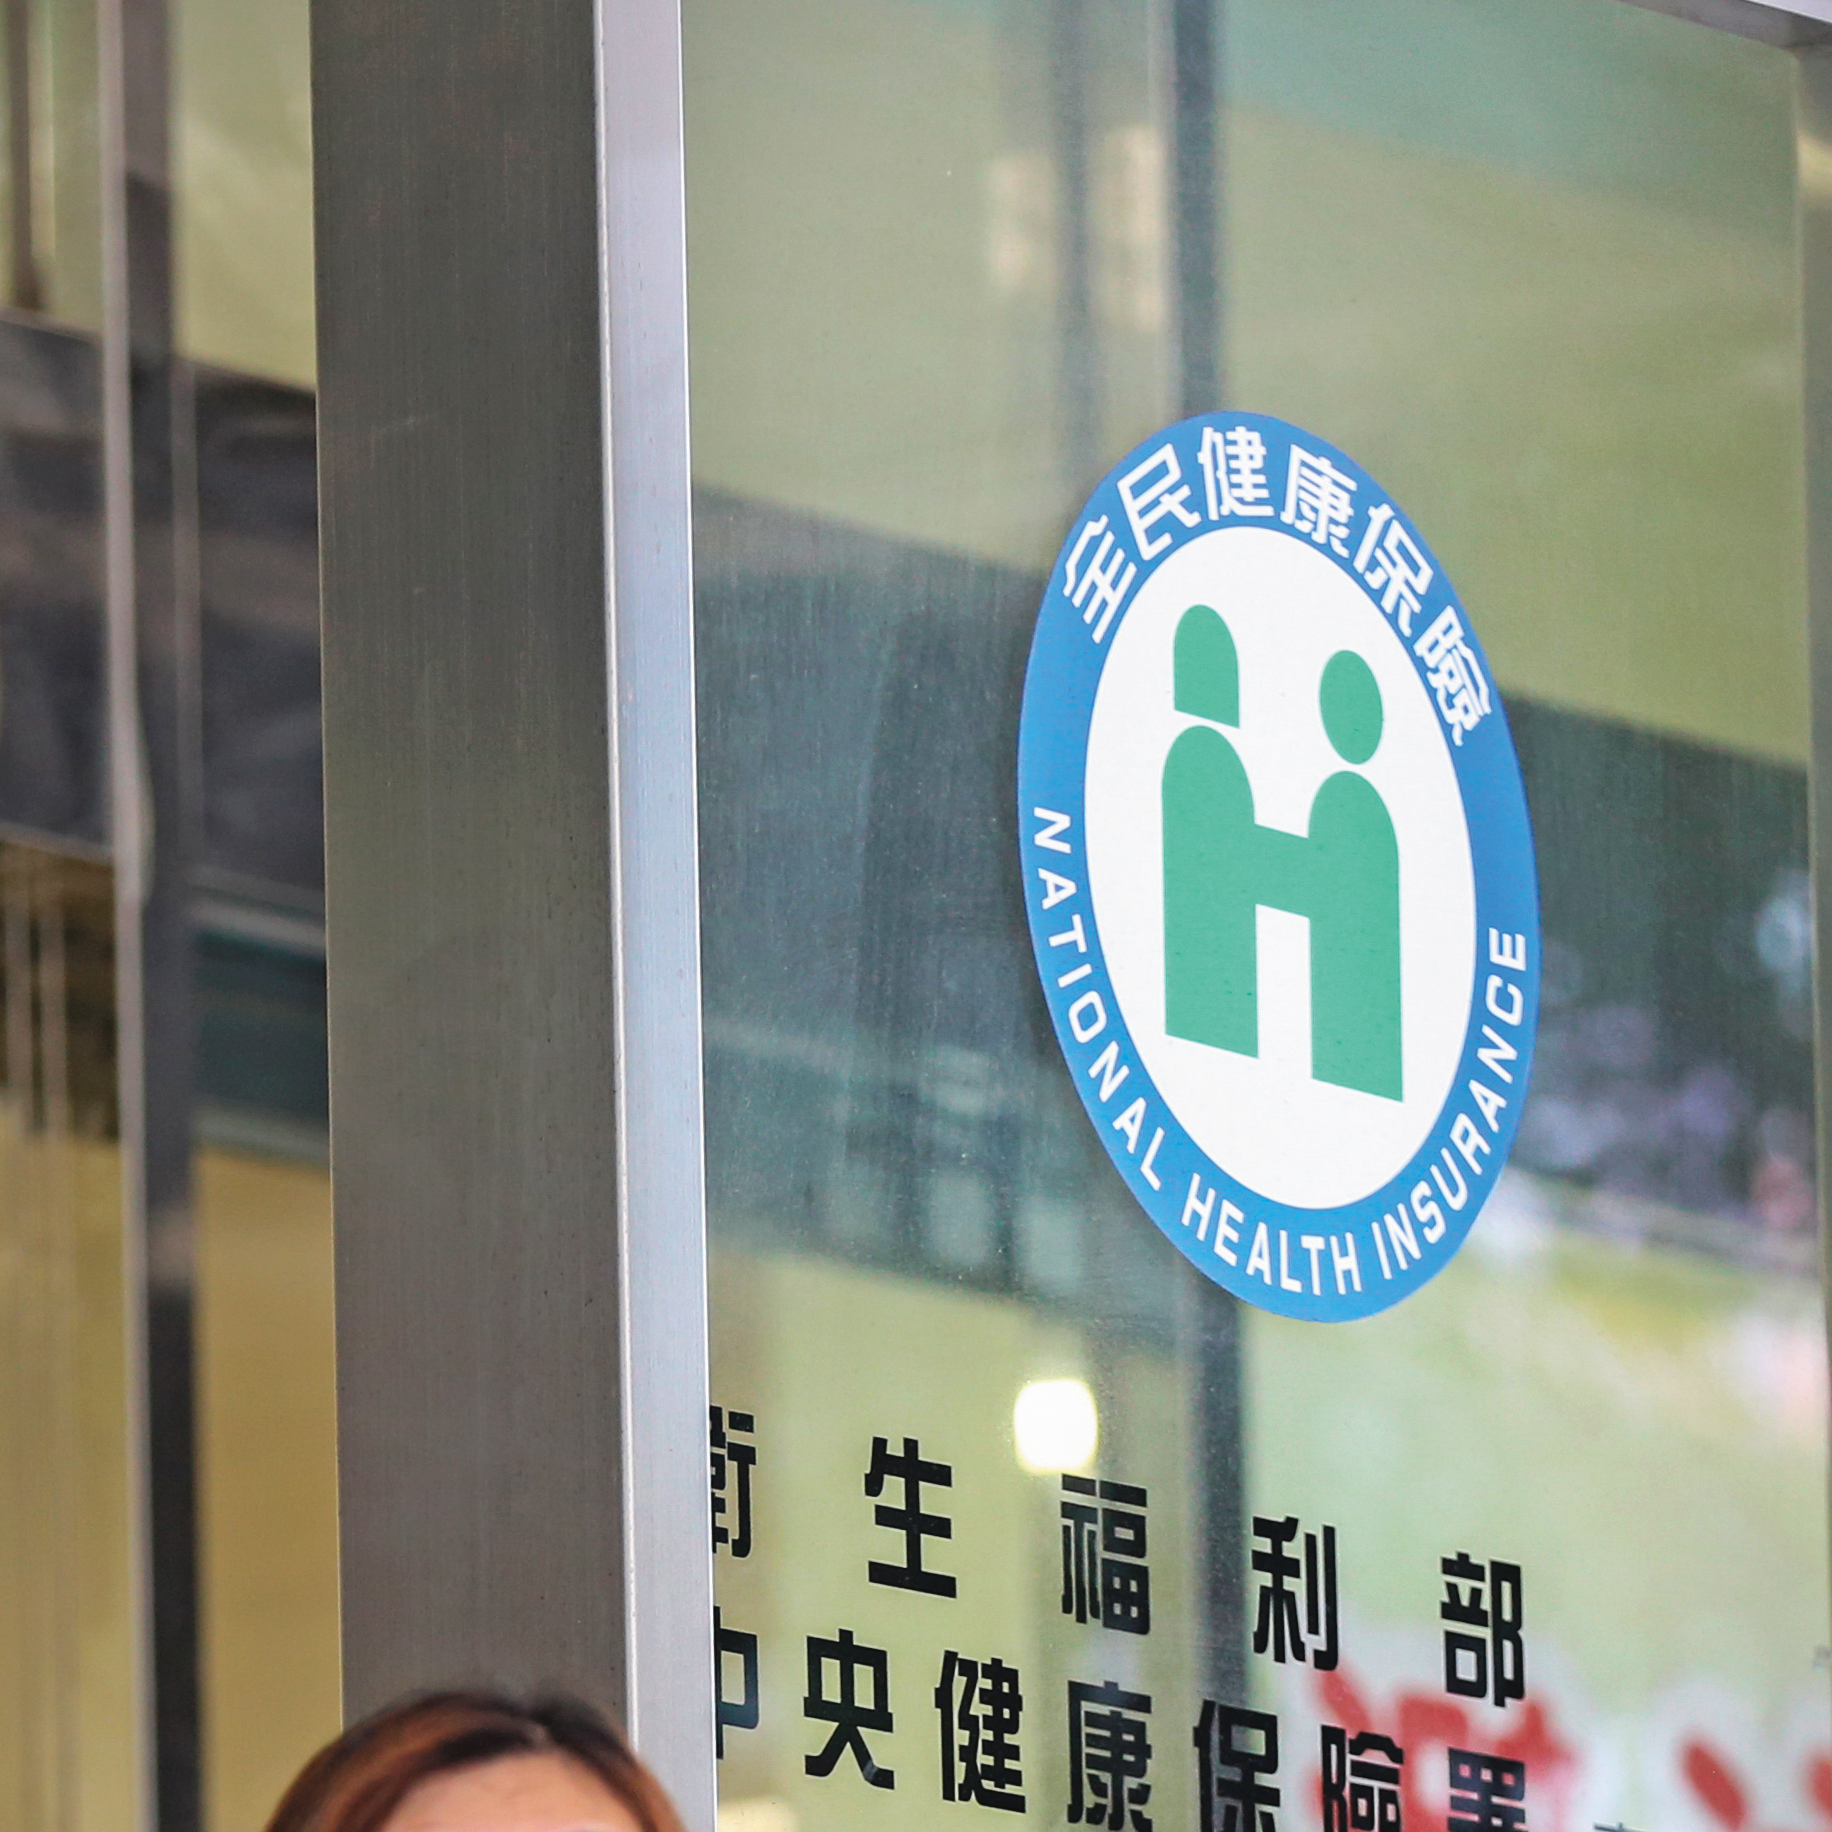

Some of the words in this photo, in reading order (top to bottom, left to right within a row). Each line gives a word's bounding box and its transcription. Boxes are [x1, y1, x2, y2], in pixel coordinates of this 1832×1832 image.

[1064, 426, 1492, 746] 全民健康保險
[1034, 807, 1164, 1191] NATIONAL
[1181, 1173, 1363, 1295] HEALTH
[1376, 927, 1526, 1280] INSURANCE
